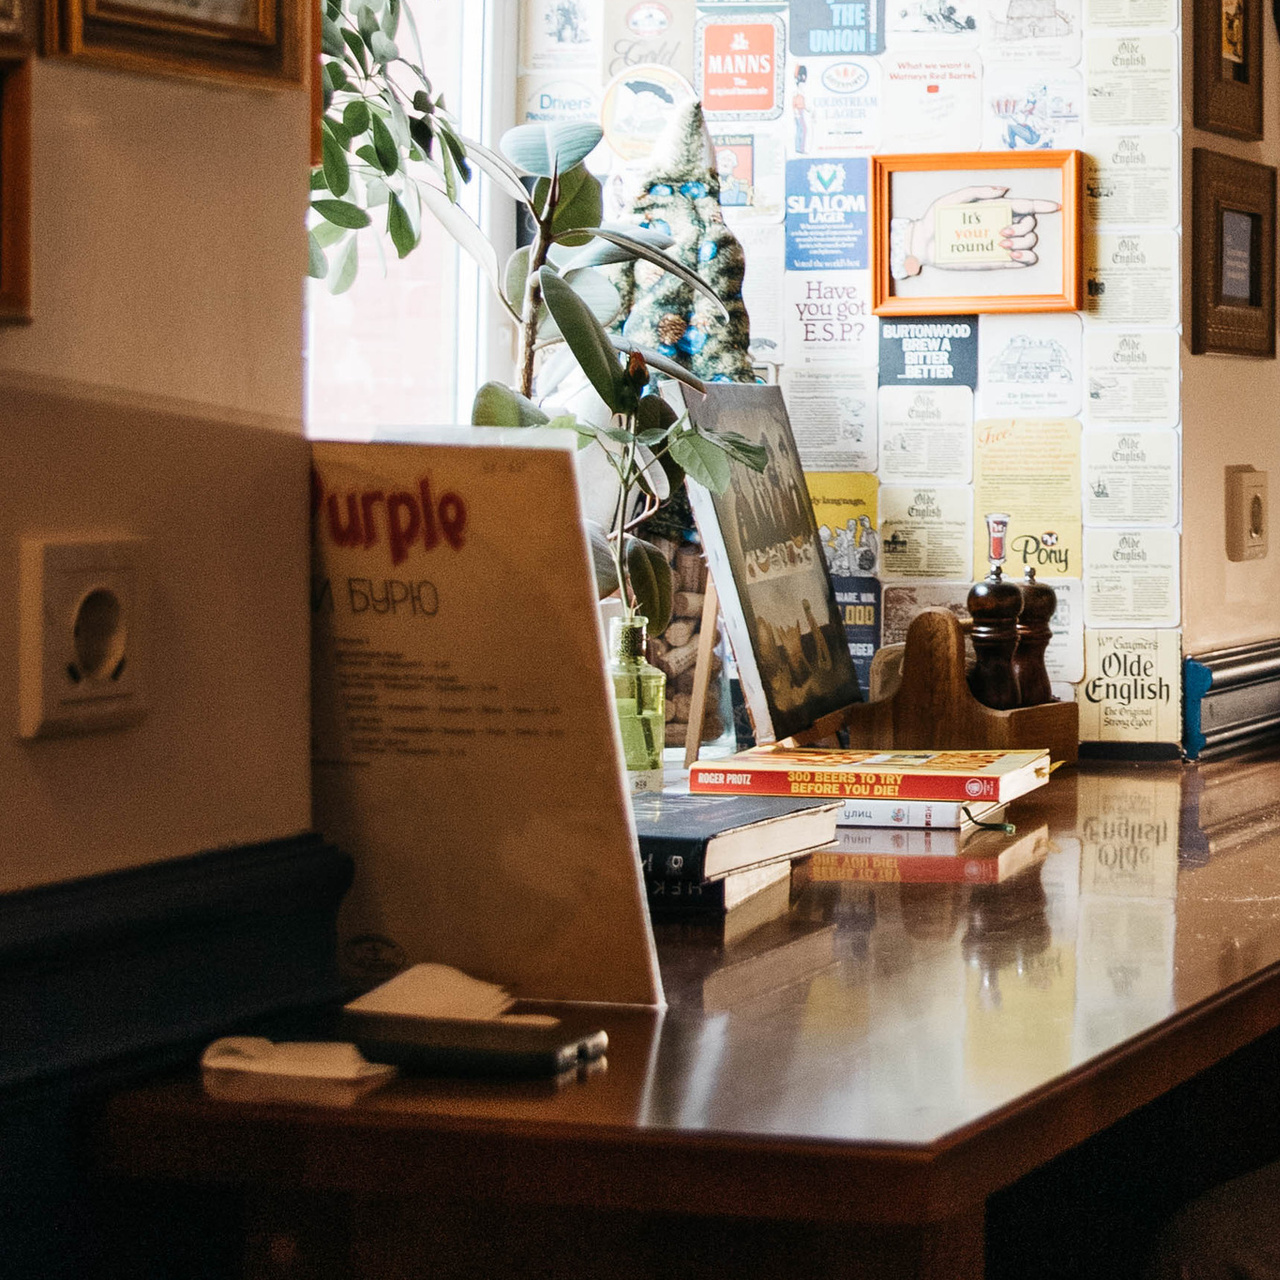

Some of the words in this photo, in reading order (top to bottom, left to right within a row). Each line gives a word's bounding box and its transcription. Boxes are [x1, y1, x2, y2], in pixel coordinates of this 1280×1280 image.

[830, 3, 866, 27] THE
[708, 54, 772, 74] MANNS
[897, 61, 923, 70] What
[939, 62, 963, 70] want
[963, 61, 971, 70] is
[1111, 55, 1146, 69] English
[889, 71, 928, 82] Watneys
[929, 71, 946, 80] Red
[540, 94, 591, 111] Drivers
[824, 109, 867, 119] LAGER
[1111, 152, 1146, 166] English
[787, 195, 866, 213] SLALOM
[808, 212, 845, 223] LAGER
[962, 211, 981, 225] It's
[955, 228, 990, 240] your
[950, 239, 995, 253] round
[1111, 252, 1146, 266] English
[805, 281, 857, 300] Have
[795, 302, 833, 321] you
[836, 300, 866, 320] got
[882, 324, 971, 338] BURTONWOOD
[902, 338, 938, 351] BREW
[939, 338, 951, 351] A
[904, 351, 949, 364] BITTER
[1112, 350, 1147, 364] English
[907, 407, 943, 421] English
[978, 420, 1016, 448] Free!
[1111, 450, 1146, 464] English
[907, 505, 943, 519] English
[1011, 534, 1069, 574] Pony
[1112, 549, 1147, 563] English
[348, 577, 440, 617] БУРЮ
[1101, 651, 1155, 679] Olde
[1085, 677, 1171, 707] English
[1104, 706, 1118, 716] The
[1119, 706, 1152, 720] Original
[1104, 717, 1130, 730] Strong
[698, 772, 725, 784] ROGER
[726, 773, 752, 785] PROTZ
[787, 771, 811, 782] 300
[814, 771, 856, 783] BEERS
[860, 774, 877, 785] TO
[880, 774, 902, 785] TRY
[790, 782, 839, 795] BEFORE
[844, 784, 871, 795] YOU
[873, 784, 900, 796] DIE!
[843, 809, 873, 819] улиц
